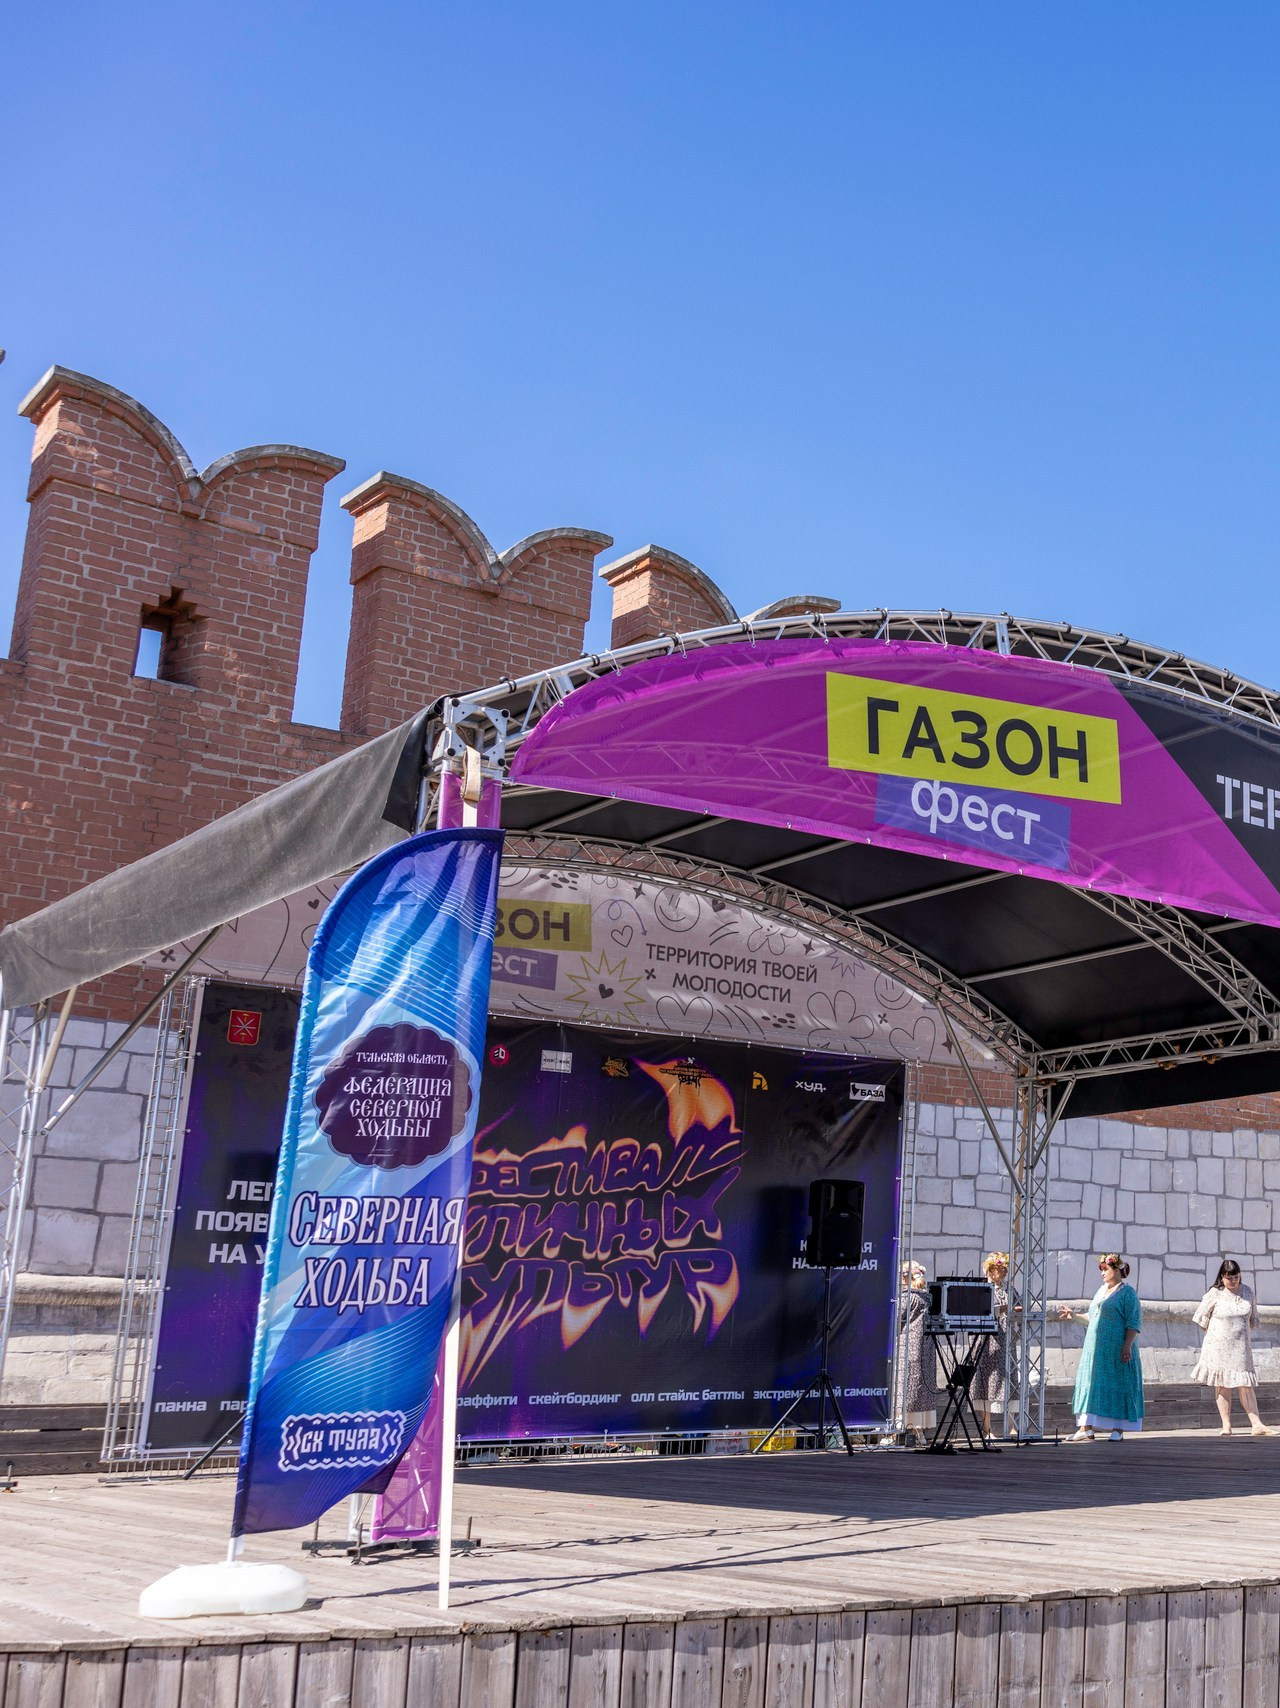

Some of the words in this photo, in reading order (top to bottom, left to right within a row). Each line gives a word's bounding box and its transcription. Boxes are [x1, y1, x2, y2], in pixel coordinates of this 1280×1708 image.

[867, 696, 1089, 783] ГАЗОН
[911, 780, 1041, 845] фест
[646, 943, 757, 975] ТЕРРИТОРИЯ
[761, 959, 818, 983] ТВОЕЙ
[672, 973, 792, 1004] МОЛОДОСТИ
[355, 1051, 405, 1064] ТУЛЬСКАЯ
[407, 1053, 448, 1065] ОБЛАСТЬ
[343, 1076, 452, 1099] ФЕДЕРАЦИЯ
[860, 1089, 885, 1098] БАЗА
[350, 1097, 442, 1119] СЕВЕРНОЙ
[355, 1118, 432, 1140] ХОДЬБЫ
[289, 1191, 464, 1247] СЕВЕРНАЯ
[208, 1243, 247, 1264] НА
[294, 1257, 432, 1315] ХОДЬБА
[154, 1400, 207, 1413] панна
[528, 1392, 621, 1406] скейтбординг
[631, 1391, 655, 1403] олл
[658, 1388, 700, 1402] стайлс
[702, 1388, 745, 1401] баттлы
[844, 1386, 889, 1398] самокат
[301, 1430, 323, 1453] СХ
